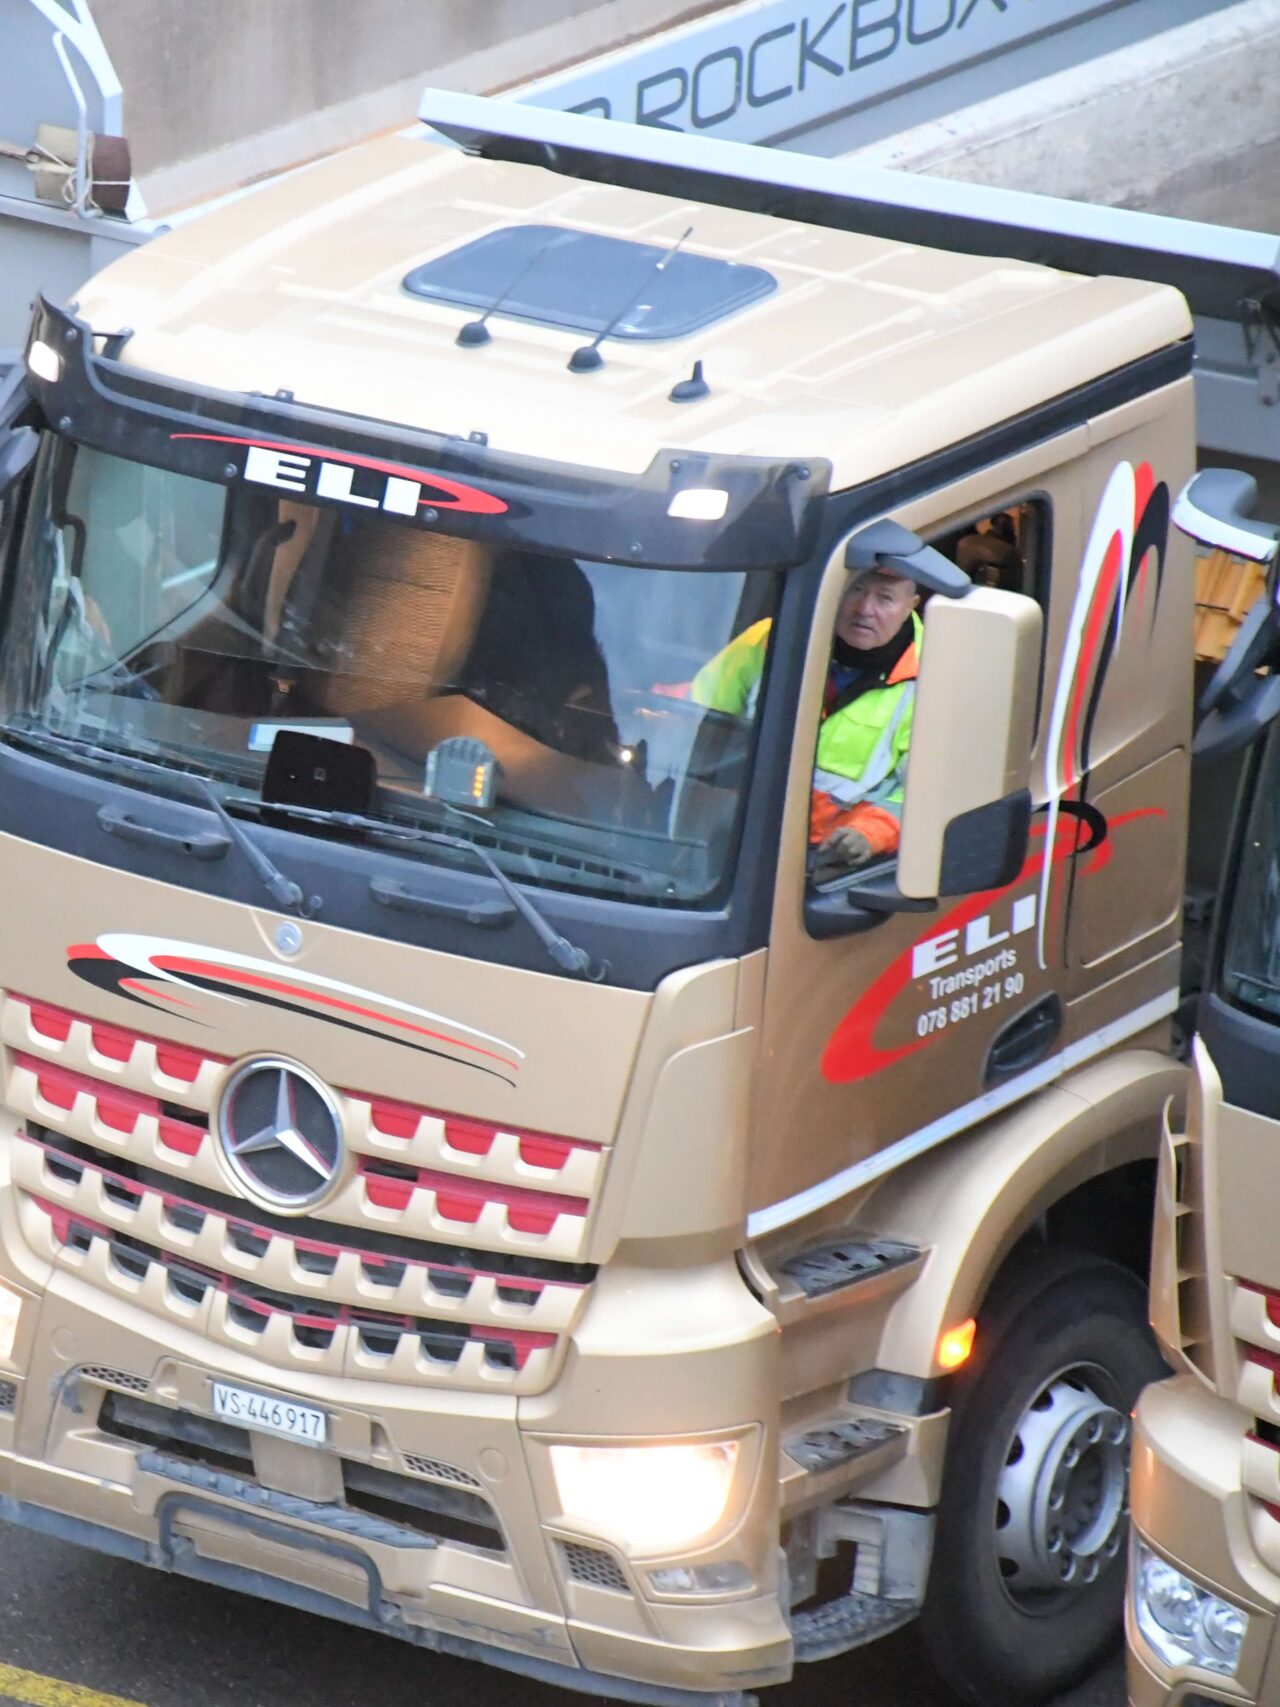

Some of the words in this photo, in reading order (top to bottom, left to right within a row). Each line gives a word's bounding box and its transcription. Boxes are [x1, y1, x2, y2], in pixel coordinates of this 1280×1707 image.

[244, 446, 421, 517] ELI
[912, 894, 1036, 979] ELI
[917, 1006, 947, 1037] 078
[950, 993, 978, 1024] 881
[982, 982, 1001, 1009] 21
[1004, 972, 1024, 1000] 90
[929, 949, 1017, 1000] Transports
